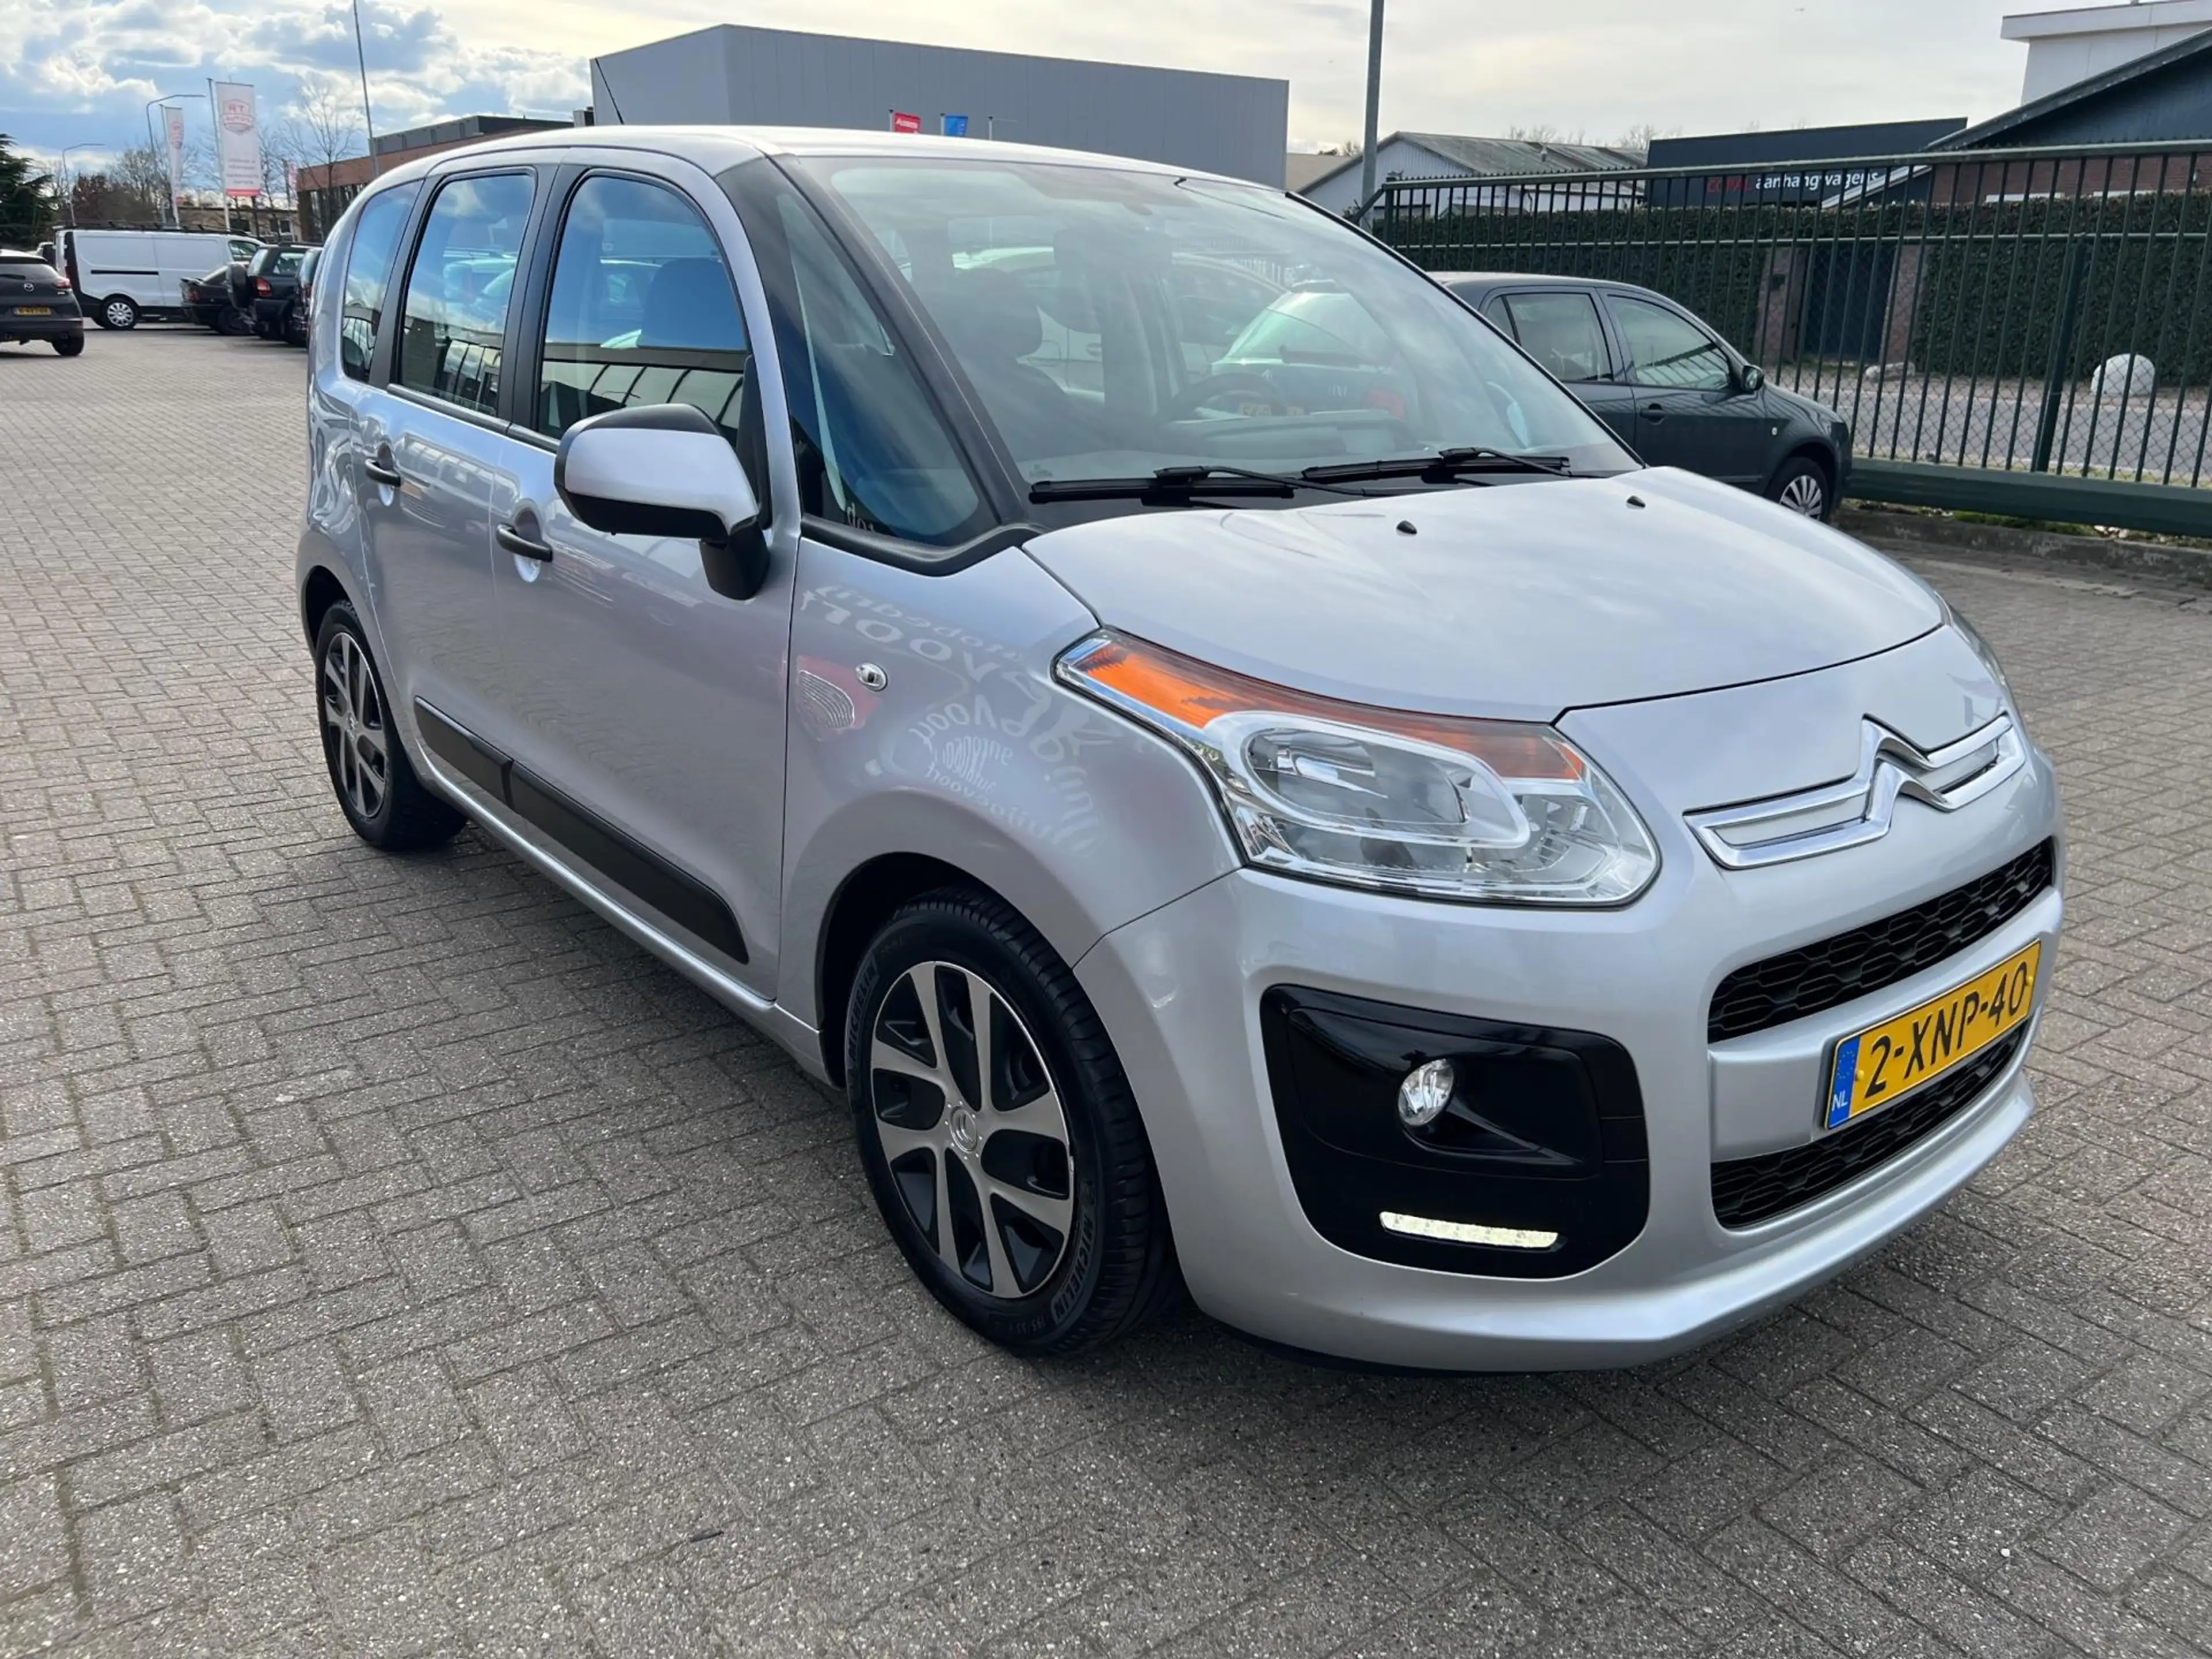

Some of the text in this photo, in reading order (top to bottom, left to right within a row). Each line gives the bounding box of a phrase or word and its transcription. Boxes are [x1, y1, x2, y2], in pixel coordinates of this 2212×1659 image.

[1864, 961, 2027, 1099] 2-XNP-40
[1831, 1089, 1849, 1112] NL
[1052, 1210, 1094, 1319] MICHELIN
